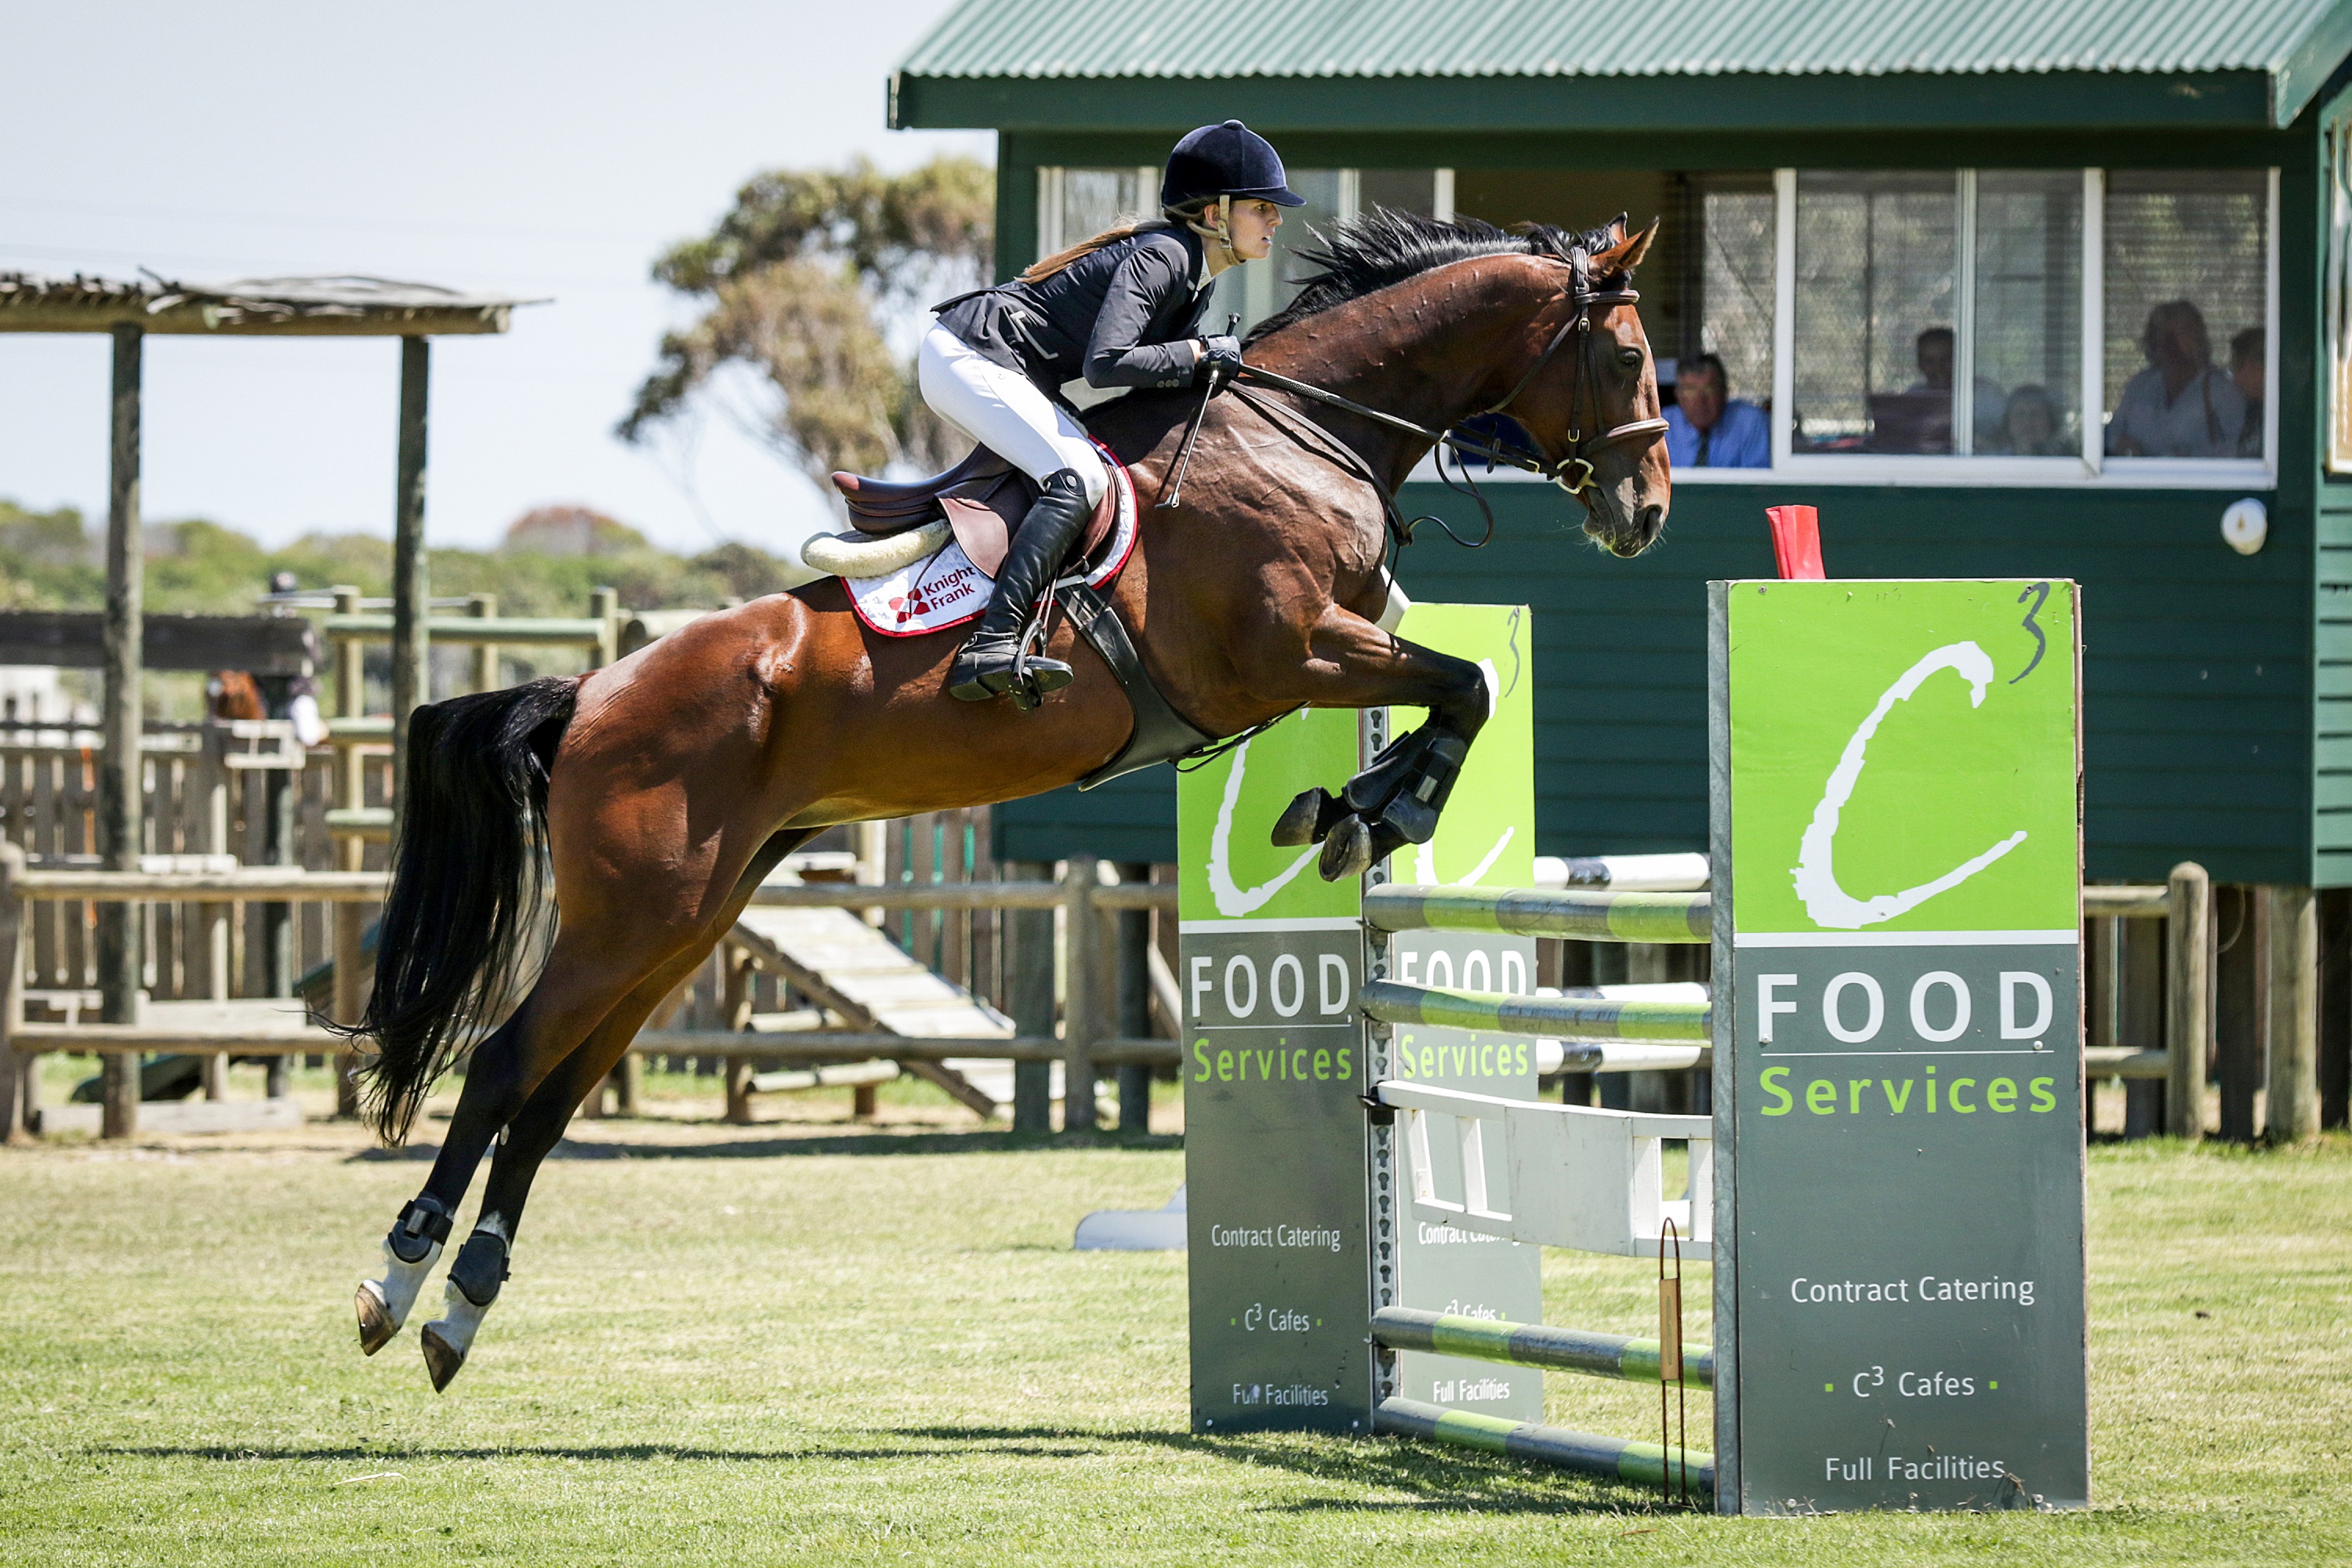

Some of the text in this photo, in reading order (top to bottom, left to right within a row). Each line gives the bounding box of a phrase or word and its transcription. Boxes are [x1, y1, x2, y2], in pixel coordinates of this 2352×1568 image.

[924, 567, 975, 596] Knight
[930, 583, 975, 610] Frank
[1191, 953, 1350, 1018] FOOD
[1758, 971, 2053, 1044] FOOD
[1193, 1037, 1352, 1083] Services
[1401, 1033, 1528, 1079] Services
[1759, 1065, 2056, 1116] Services
[1211, 1224, 1341, 1252] Contract Catering
[1791, 1276, 2035, 1306] Contract Catering
[1269, 1308, 1310, 1331] Cafes
[1265, 1384, 1329, 1406] Facilities
[1433, 1377, 1511, 1403] Full Facilities
[1898, 1371, 1975, 1396] Cafes
[1826, 1455, 2005, 1481] Full Facilities
